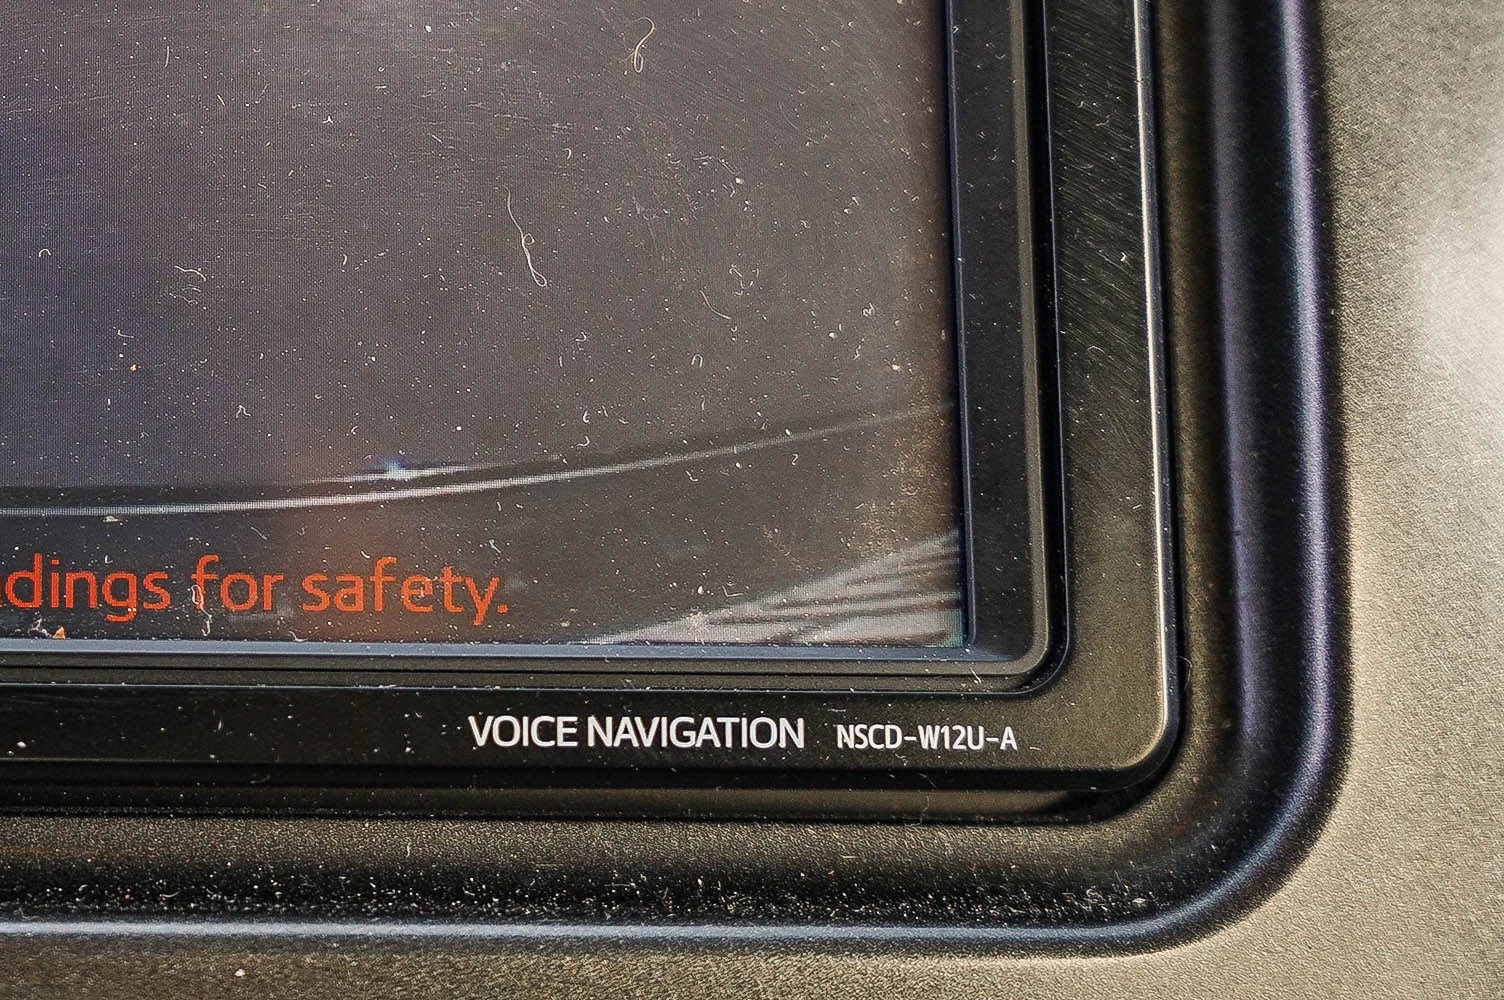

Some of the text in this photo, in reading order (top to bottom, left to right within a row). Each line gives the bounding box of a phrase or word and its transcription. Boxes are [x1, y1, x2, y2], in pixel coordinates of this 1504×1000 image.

[191, 554, 284, 613] for
[301, 556, 509, 627] safety.
[468, 715, 1018, 752] VOICE NAVIGATION NSCD-W12U-A
